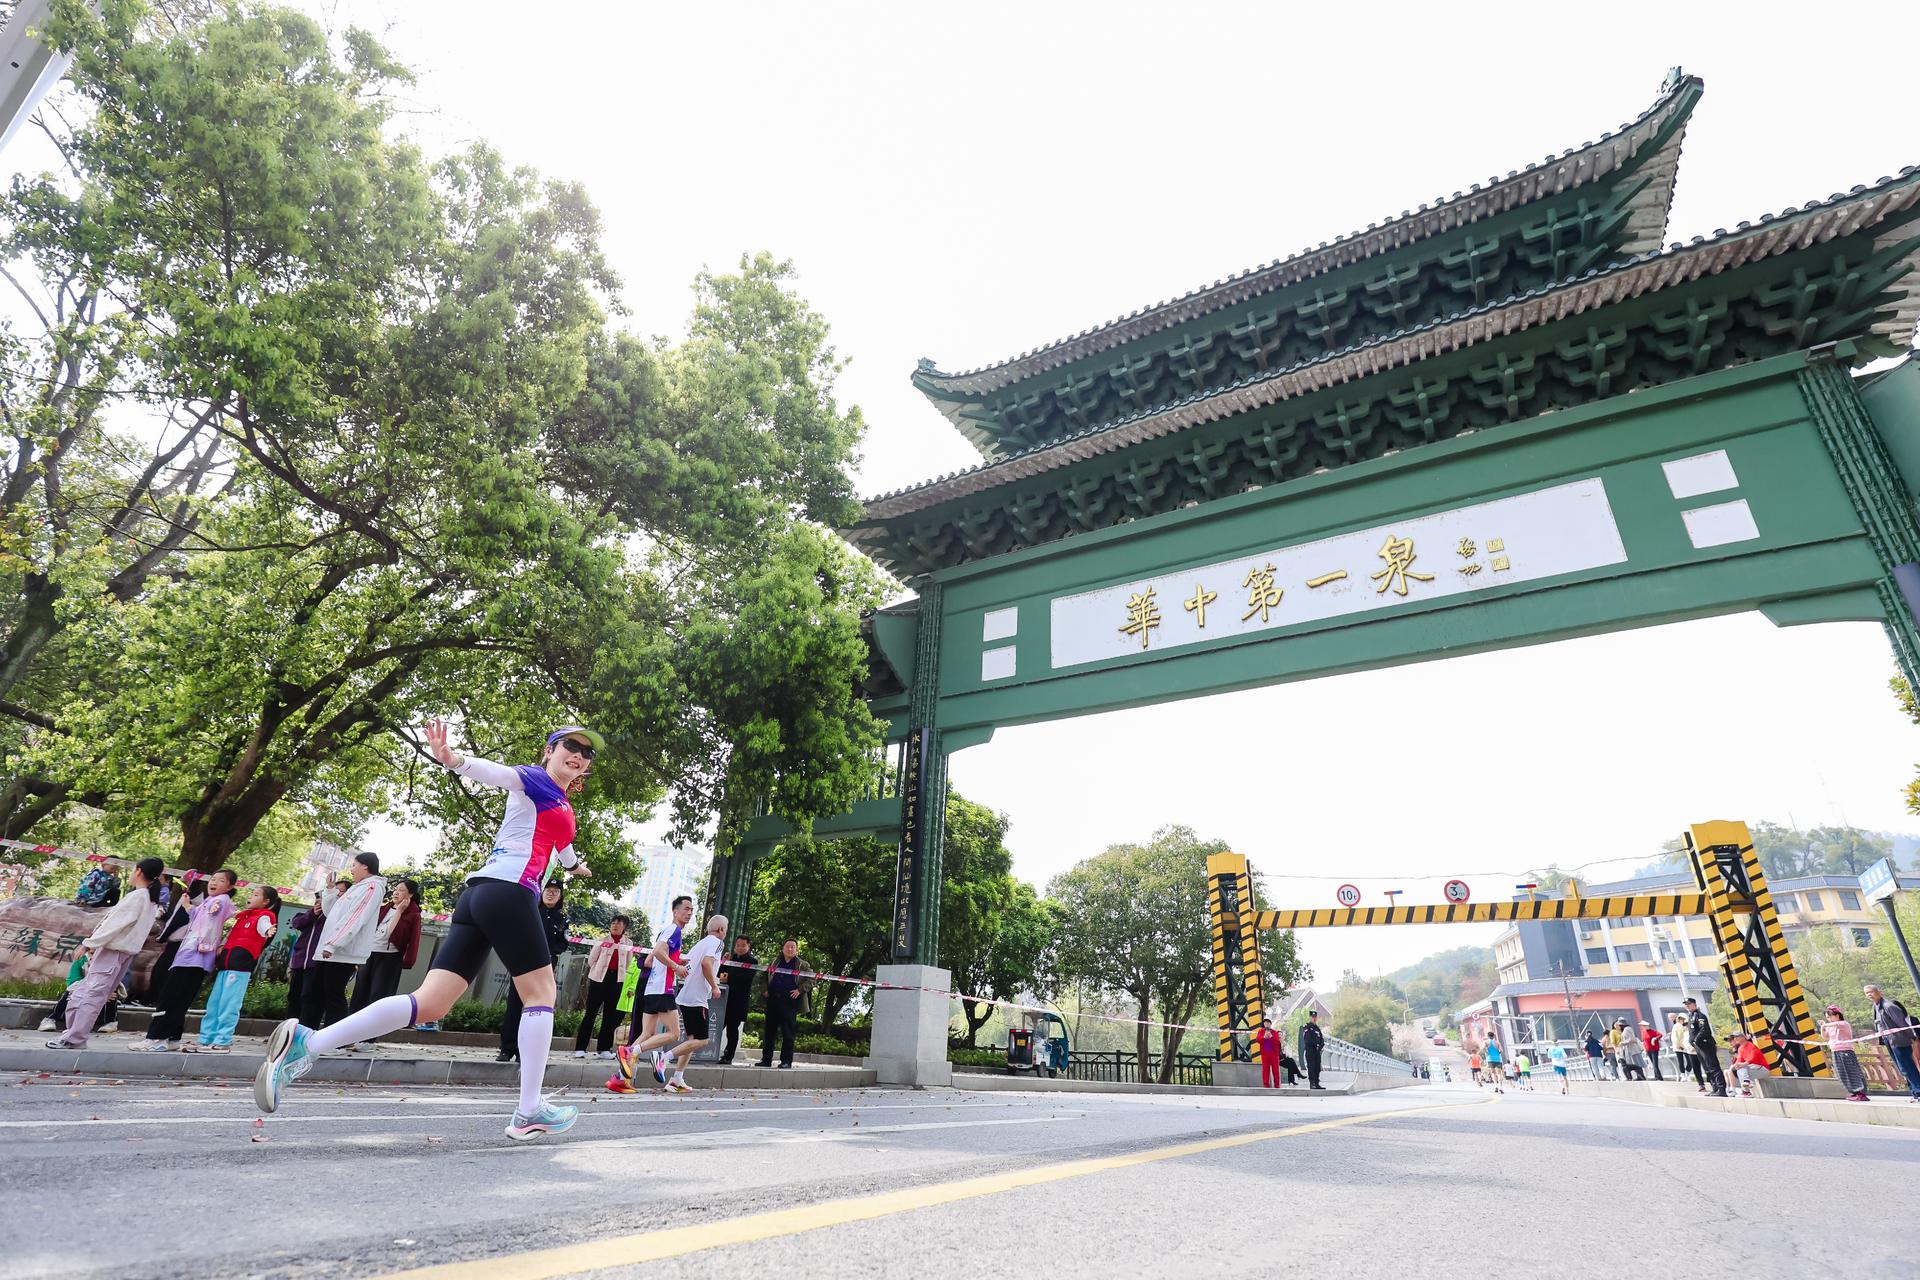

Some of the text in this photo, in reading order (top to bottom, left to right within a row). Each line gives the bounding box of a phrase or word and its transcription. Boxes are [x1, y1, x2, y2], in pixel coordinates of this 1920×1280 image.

[1118, 534, 1435, 648] 華中第一泉
